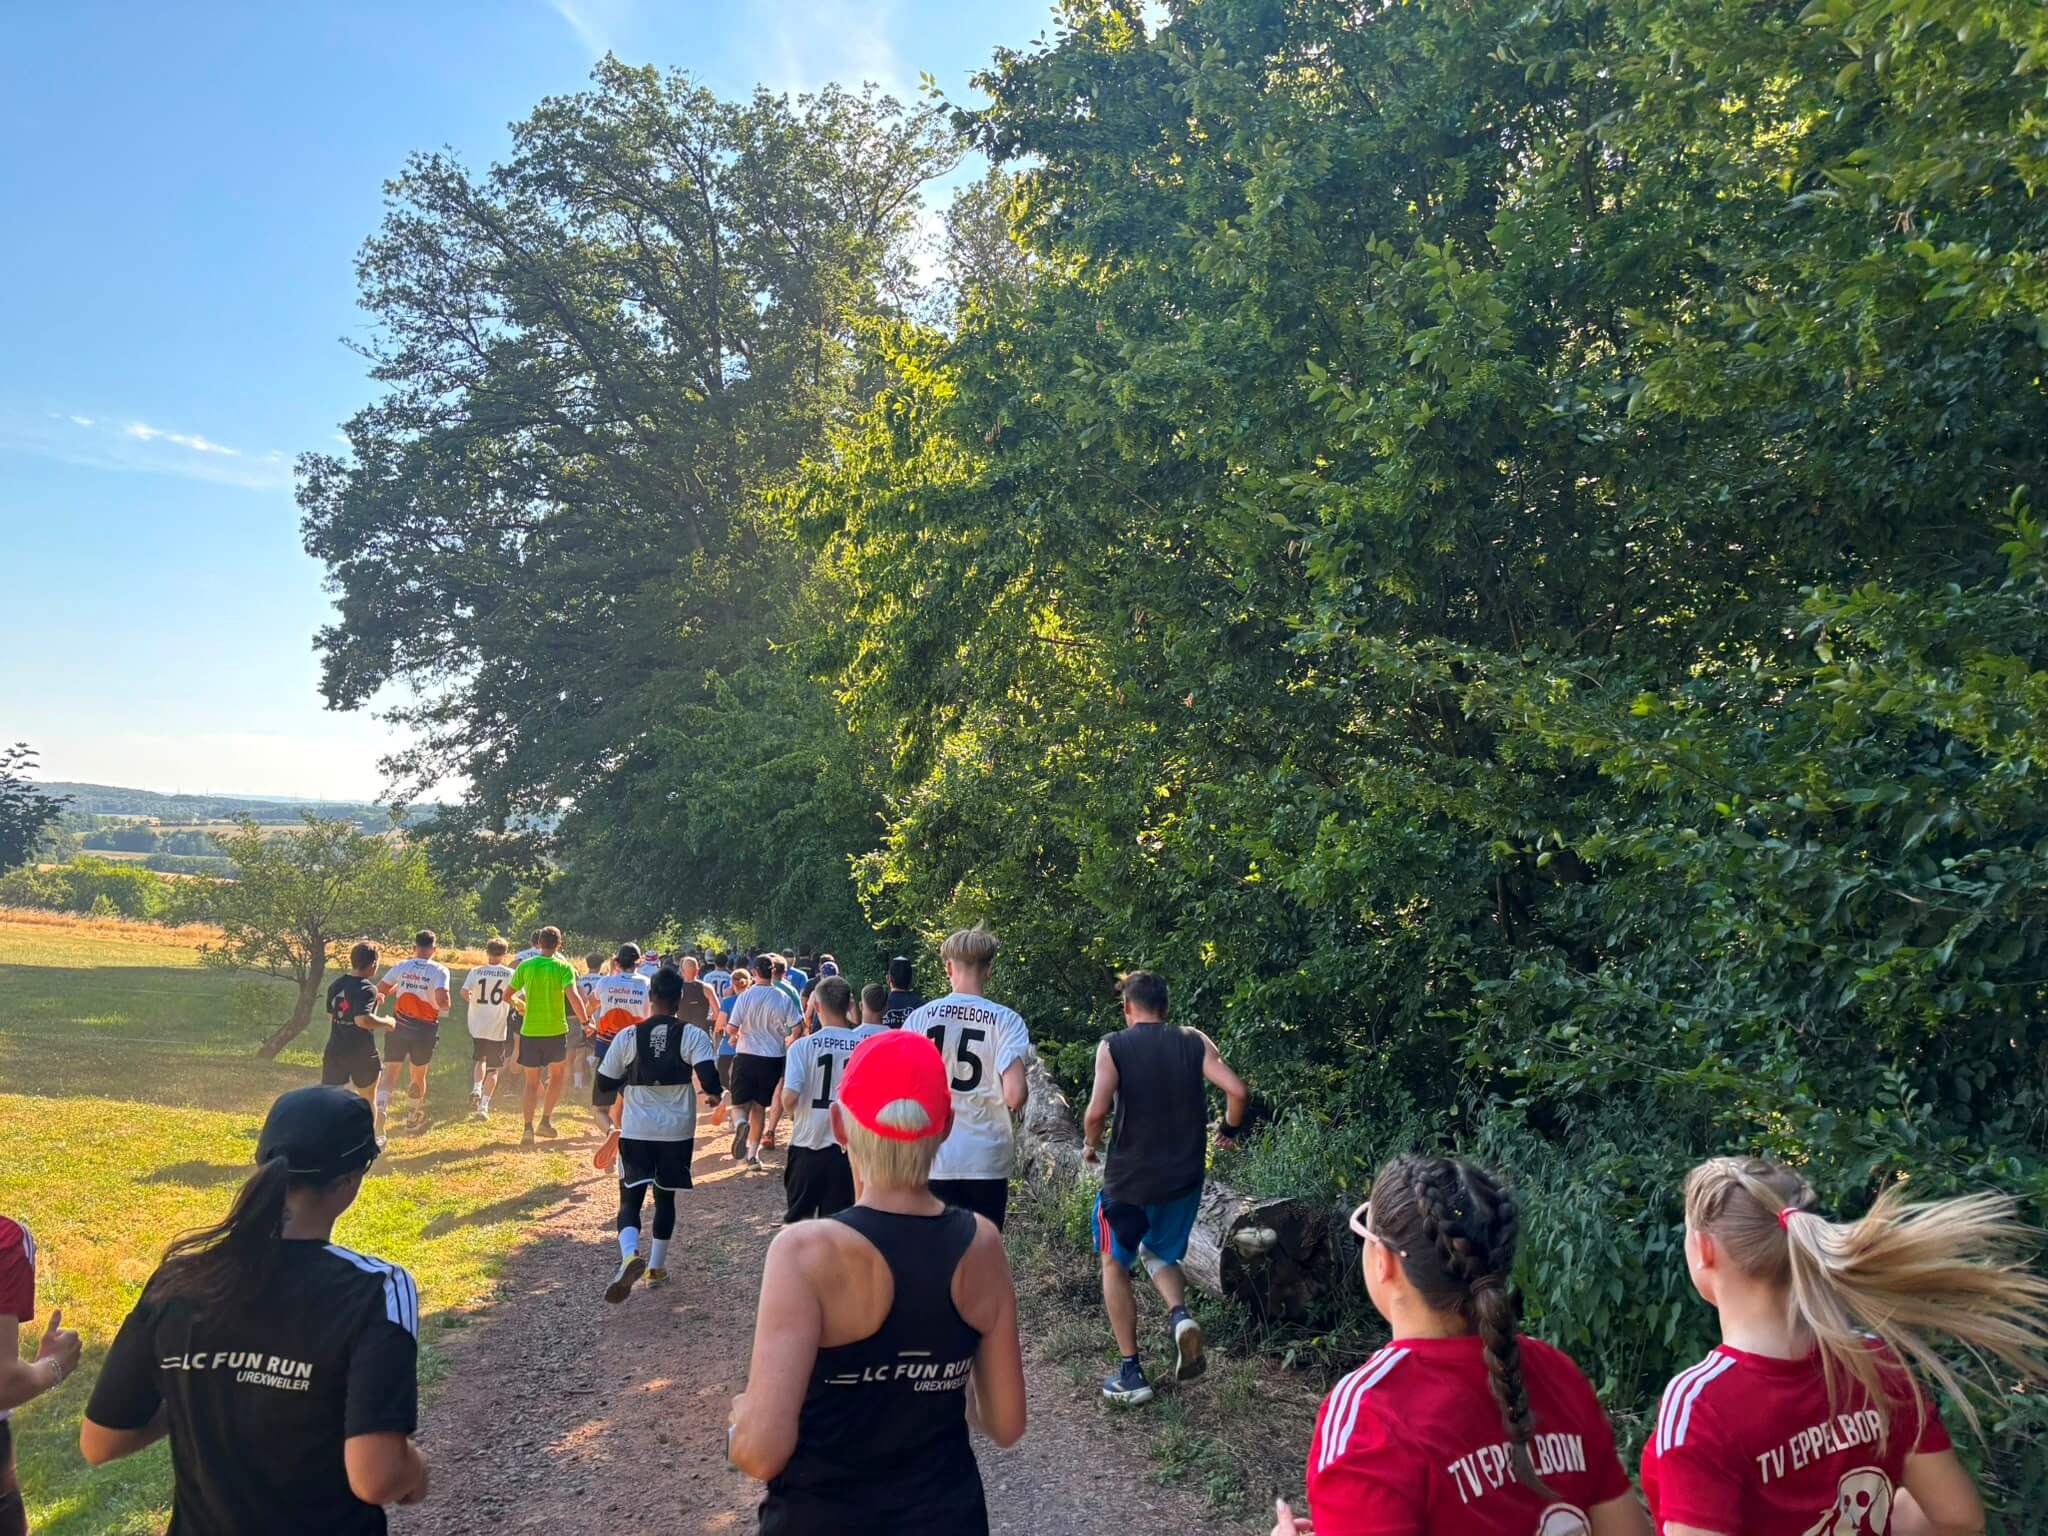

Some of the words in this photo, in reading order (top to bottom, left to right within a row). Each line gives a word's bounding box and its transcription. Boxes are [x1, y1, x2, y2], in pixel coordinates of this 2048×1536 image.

[477, 978, 503, 1005] 16
[608, 986, 631, 994] Cache
[939, 1005, 998, 1026] EPPELBORN
[926, 1024, 986, 1093] 15
[812, 1053, 850, 1109] 1
[182, 1353, 207, 1370] LC
[211, 1352, 263, 1369] FUN
[266, 1356, 313, 1378] RUN
[862, 1366, 889, 1382] LC
[894, 1364, 938, 1380] FUN
[236, 1371, 310, 1391] UREXWEILER
[1755, 1444, 1785, 1484] TV
[1788, 1409, 1883, 1471] EPPELBOR
[1447, 1453, 1483, 1504] TV
